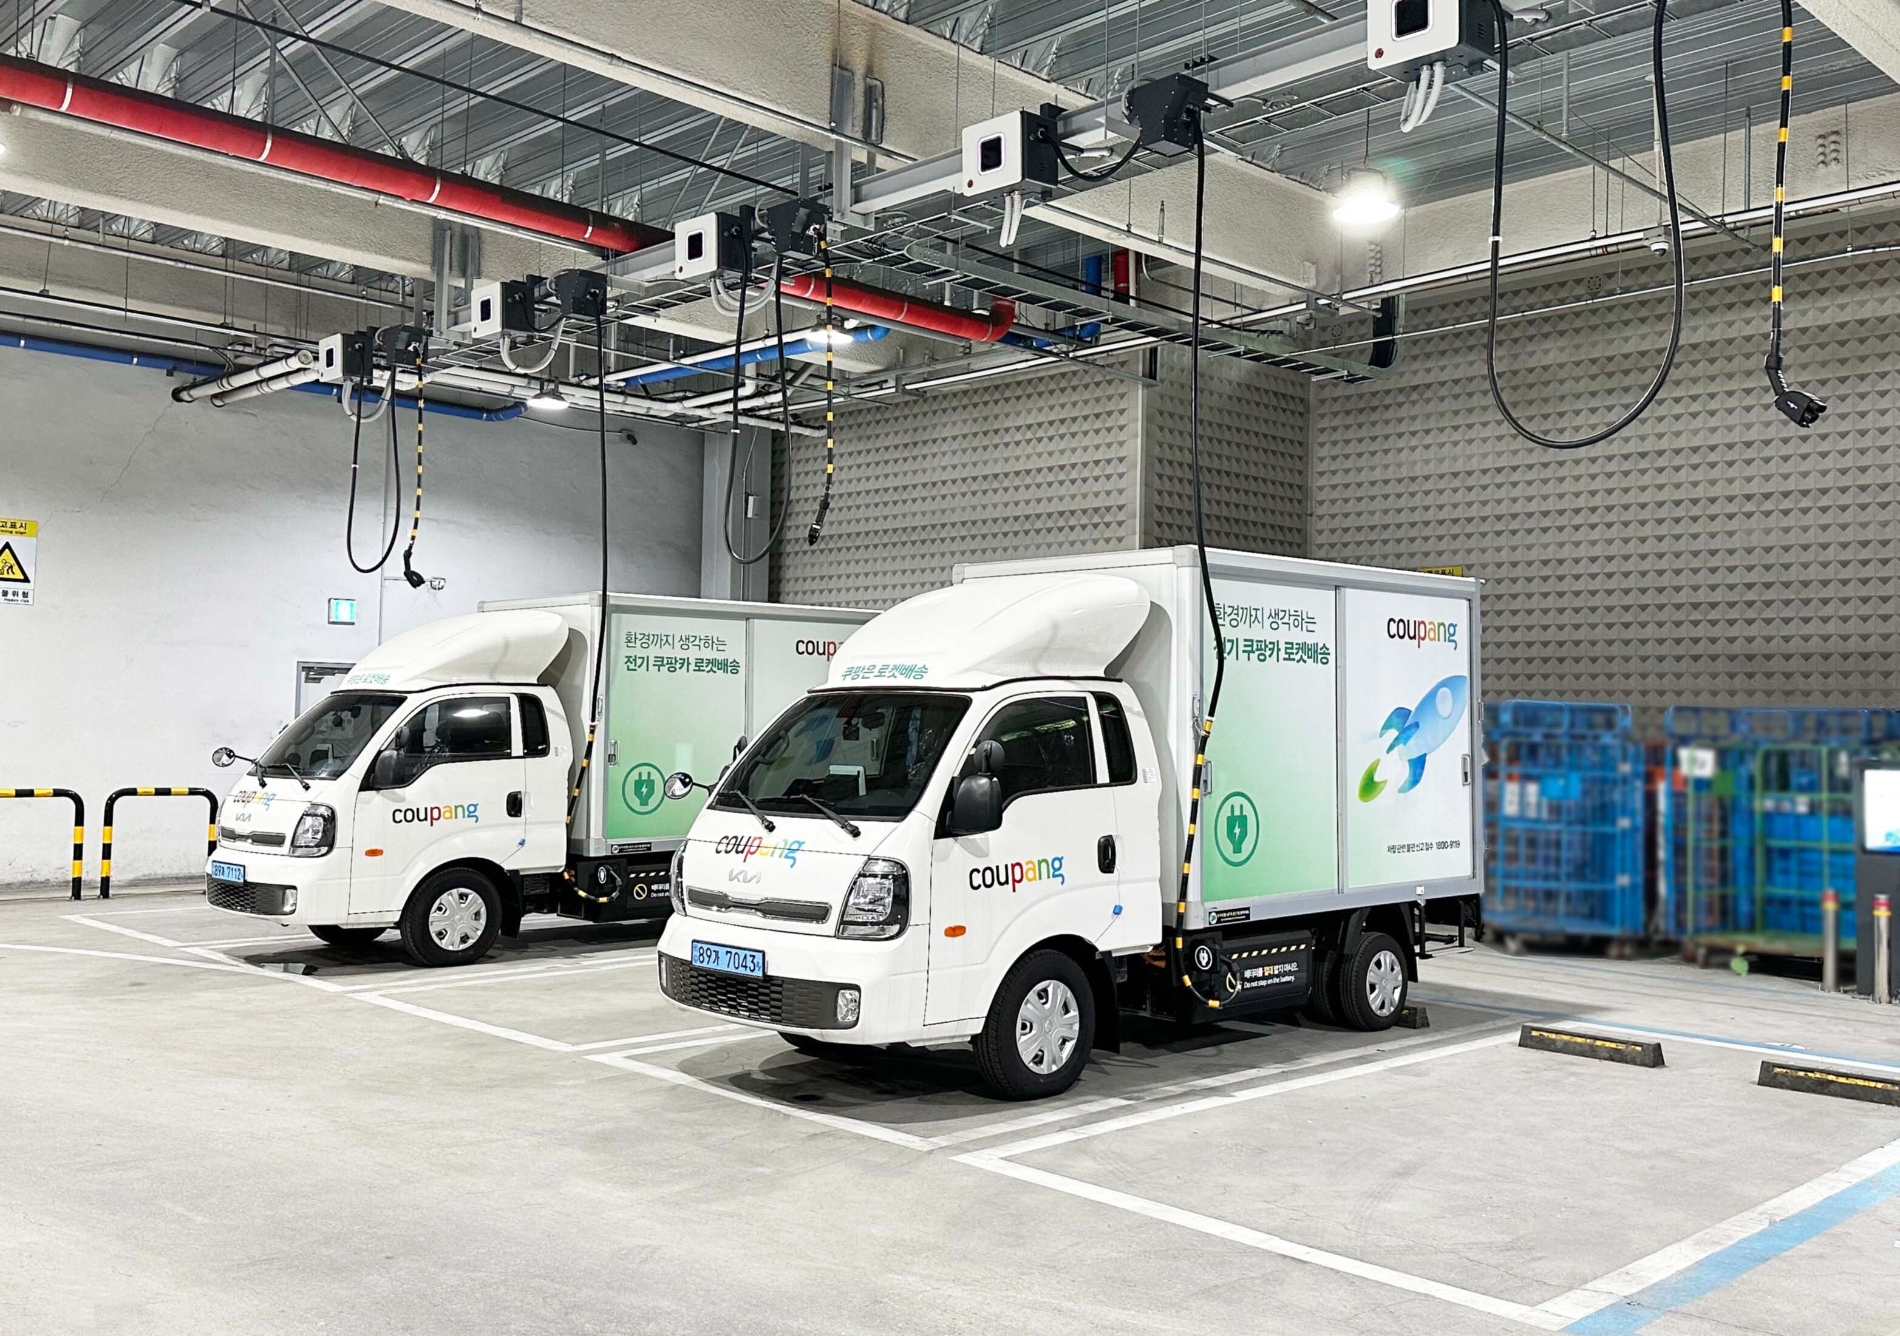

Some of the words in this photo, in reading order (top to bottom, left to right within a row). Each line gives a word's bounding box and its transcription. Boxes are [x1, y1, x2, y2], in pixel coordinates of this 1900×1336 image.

[1214, 603, 1264, 629] 환경까지
[1267, 608, 1317, 633] 생각하는
[624, 631, 675, 650] 환경까지
[678, 634, 727, 652] 생각하는
[1387, 617, 1458, 651] coupang
[795, 639, 843, 662] coup
[1242, 638, 1281, 663] 쿠팡카
[1282, 641, 1331, 665] 로켓배송
[624, 655, 650, 672] 전기
[652, 656, 691, 673] 쿠팡카
[693, 658, 741, 675] 로켓배송
[841, 664, 876, 681] 쿠팡은
[873, 663, 929, 680] 로켓배송
[392, 803, 479, 827] coupang
[715, 835, 805, 868] coupang
[969, 856, 1065, 893] coupang
[698, 946, 720, 966] 89가
[725, 950, 756, 973] 7043
